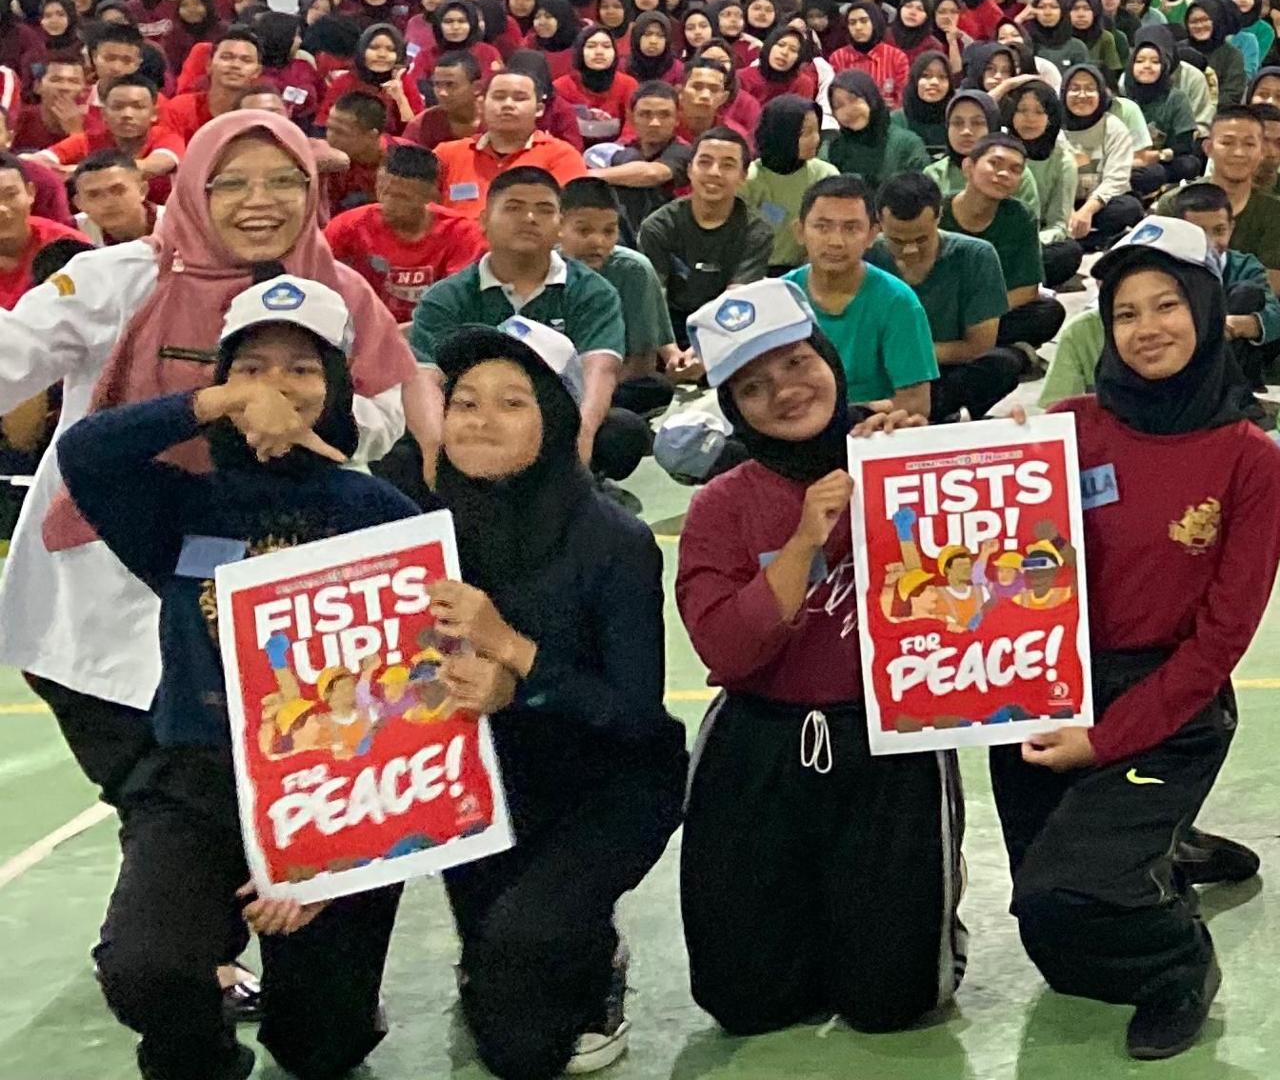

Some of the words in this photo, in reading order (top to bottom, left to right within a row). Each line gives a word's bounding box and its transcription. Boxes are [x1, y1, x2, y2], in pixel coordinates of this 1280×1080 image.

[884, 460, 1053, 521] FISTS
[918, 507, 1020, 560] UP!
[253, 565, 432, 651] FISTS
[291, 618, 401, 685] UP!
[886, 624, 1065, 703] PEACE!
[900, 631, 942, 657] FOR
[266, 735, 466, 850] PEACE!
